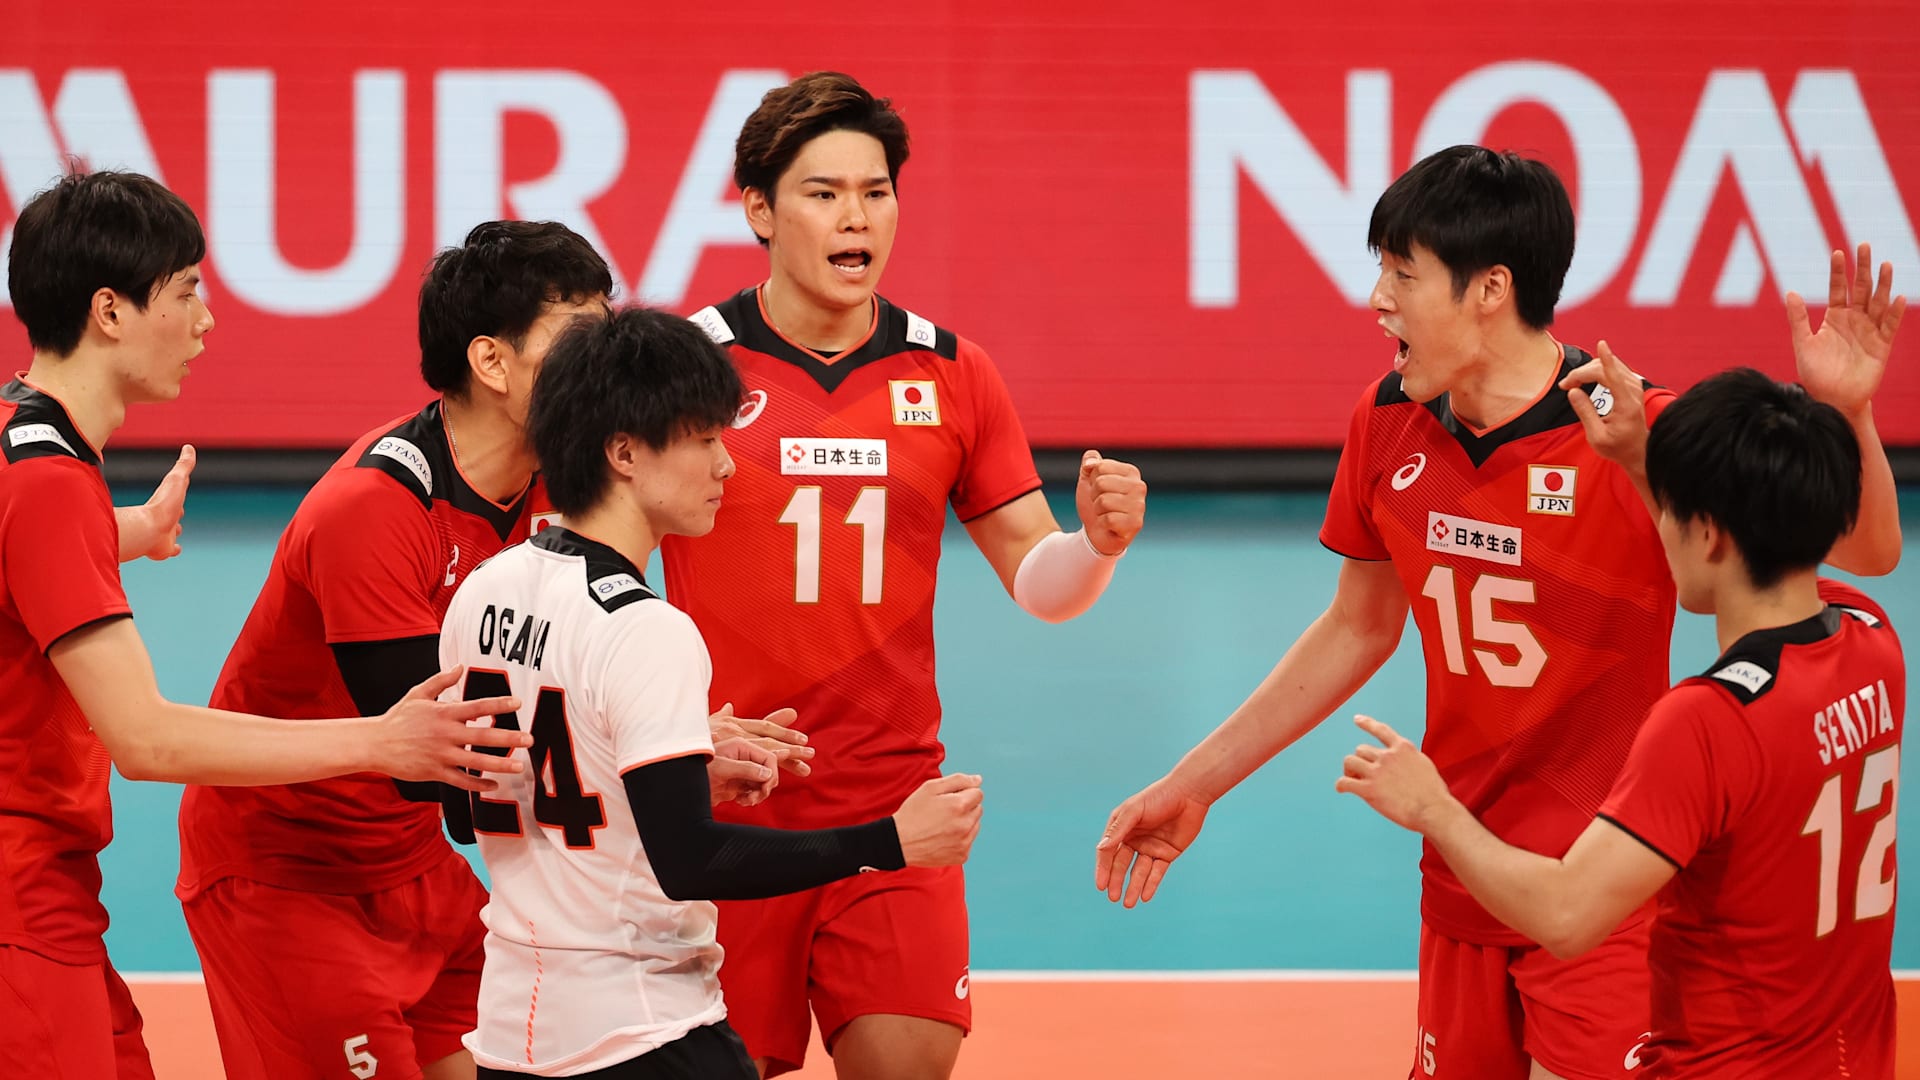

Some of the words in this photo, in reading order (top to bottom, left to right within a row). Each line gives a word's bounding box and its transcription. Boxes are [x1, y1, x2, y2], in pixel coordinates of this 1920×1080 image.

[902, 411, 932, 421] JPN
[814, 448, 881, 465] 日本生命
[1537, 498, 1570, 511] JPN
[777, 485, 888, 605] 11
[1455, 528, 1517, 555] 日本生命
[479, 605, 550, 671] OGAA
[1421, 564, 1548, 687] 15
[1814, 679, 1894, 765] SEKITA
[463, 667, 608, 850] 24
[1800, 743, 1899, 939] 12
[344, 1033, 378, 1080] 5
